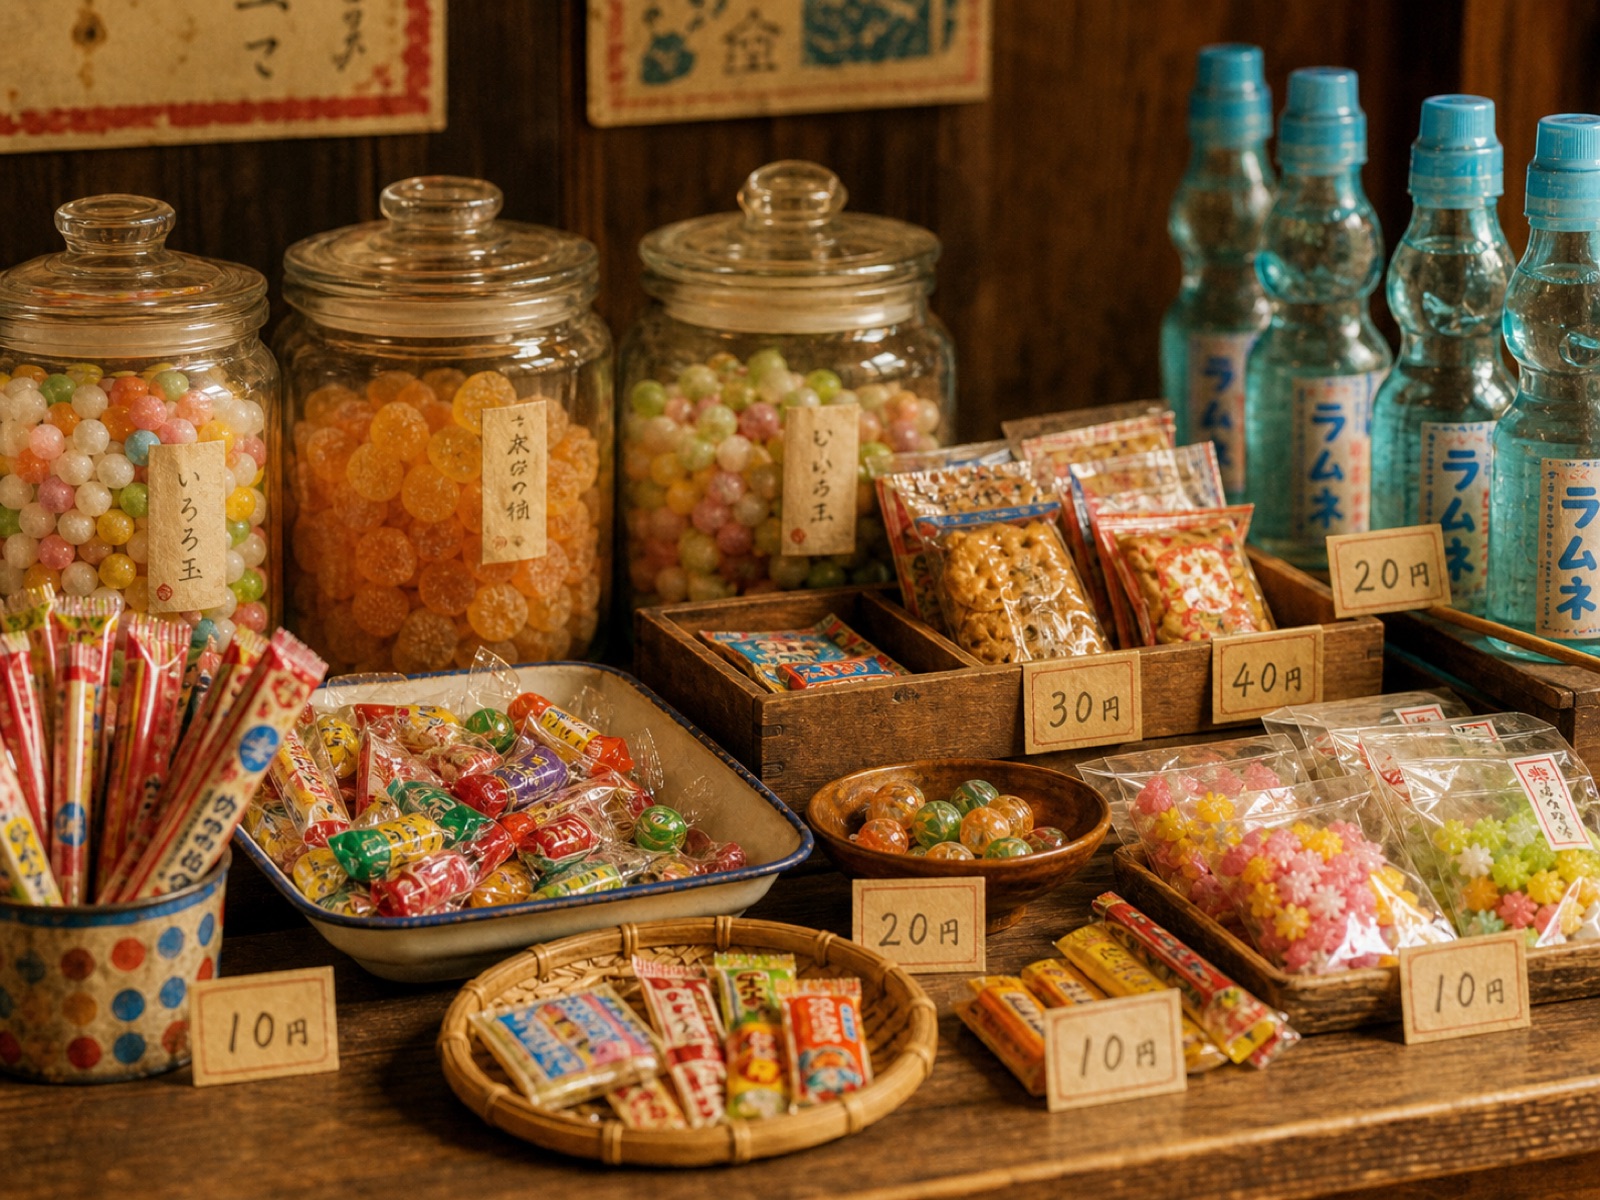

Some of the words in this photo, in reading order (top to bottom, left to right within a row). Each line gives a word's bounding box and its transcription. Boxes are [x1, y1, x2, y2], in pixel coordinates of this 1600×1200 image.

[1309, 403, 1346, 529] ラムネ
[178, 471, 203, 582] いろろ玉
[1441, 449, 1480, 582] ラムネ
[1556, 486, 1600, 621] ラムネ
[1354, 558, 1430, 594] 20円
[1232, 662, 1302, 698] 40円
[1049, 691, 1120, 728] 30円
[878, 912, 959, 947] 20円
[1435, 971, 1504, 1013] 10円
[228, 1010, 308, 1054] 10円
[1080, 1034, 1157, 1078] 10円
